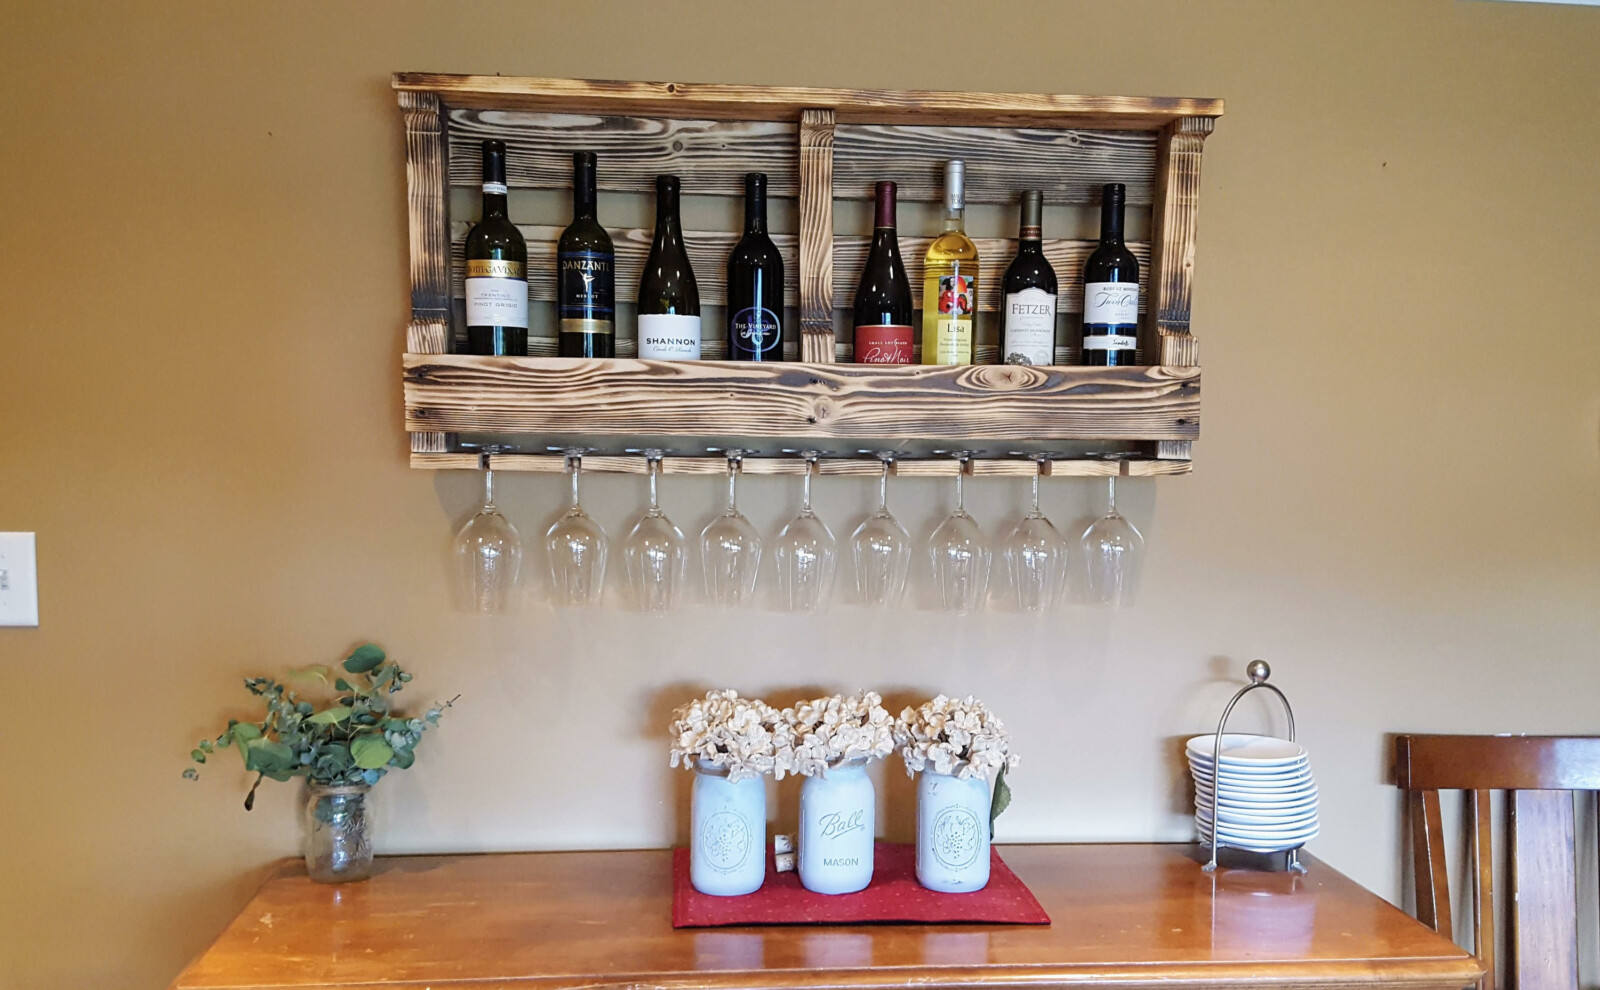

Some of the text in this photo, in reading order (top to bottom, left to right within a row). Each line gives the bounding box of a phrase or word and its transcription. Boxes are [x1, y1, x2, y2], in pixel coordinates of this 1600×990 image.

[562, 260, 610, 272] DANZANTE
[1012, 303, 1051, 317] FETZER
[646, 337, 696, 346] SHANNON
[862, 338, 910, 364] Pinot Noir
[819, 809, 864, 839] Ball
[823, 857, 859, 867] MASON
